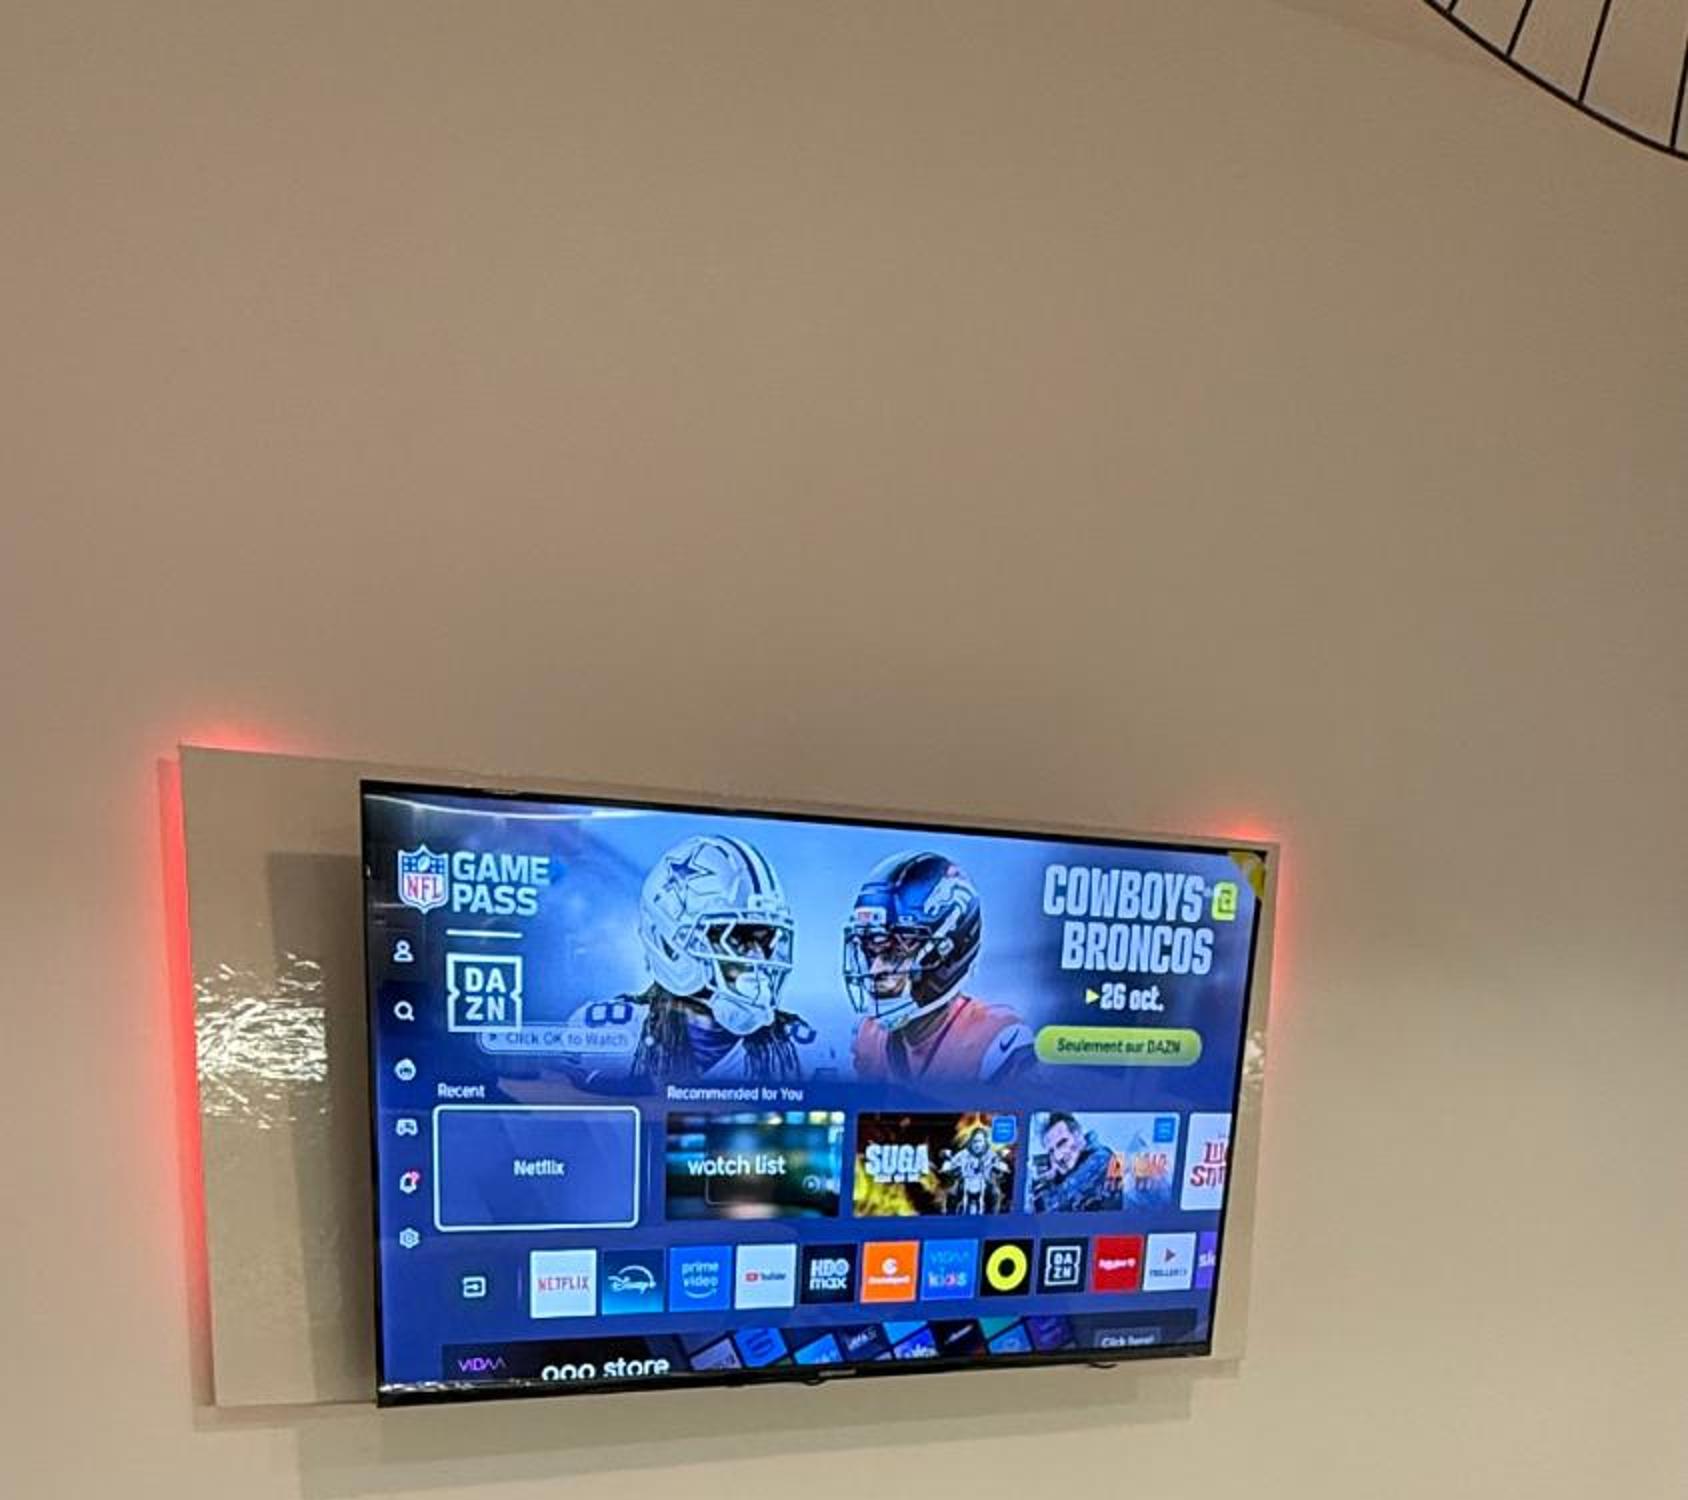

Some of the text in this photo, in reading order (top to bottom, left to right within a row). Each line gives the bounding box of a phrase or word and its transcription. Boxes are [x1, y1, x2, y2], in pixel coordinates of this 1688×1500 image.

[452, 851, 551, 886] GAME
[407, 875, 441, 900] NFL
[1043, 864, 1206, 923] COWBOYS
[452, 883, 539, 917] PASS
[1061, 921, 1215, 975] BRONCOS
[1100, 982, 1165, 1012] 26 oct.
[506, 1030, 539, 1045] Click
[567, 1030, 583, 1045] to
[585, 1030, 627, 1046] Watch
[1056, 1037, 1182, 1054] Seulement sur DAZN
[437, 1083, 485, 1099] Recent
[667, 1085, 804, 1101] Recommended for You
[513, 1159, 565, 1176] Netflix
[688, 1153, 787, 1176] watch list
[865, 1143, 929, 1174] SUGA
[681, 1261, 719, 1275] prime
[810, 1258, 850, 1277] HBO
[928, 1267, 968, 1288] kids
[538, 1276, 590, 1292] NETFLIX
[683, 1274, 719, 1287] video
[809, 1276, 848, 1291] max
[603, 1357, 670, 1378] store
